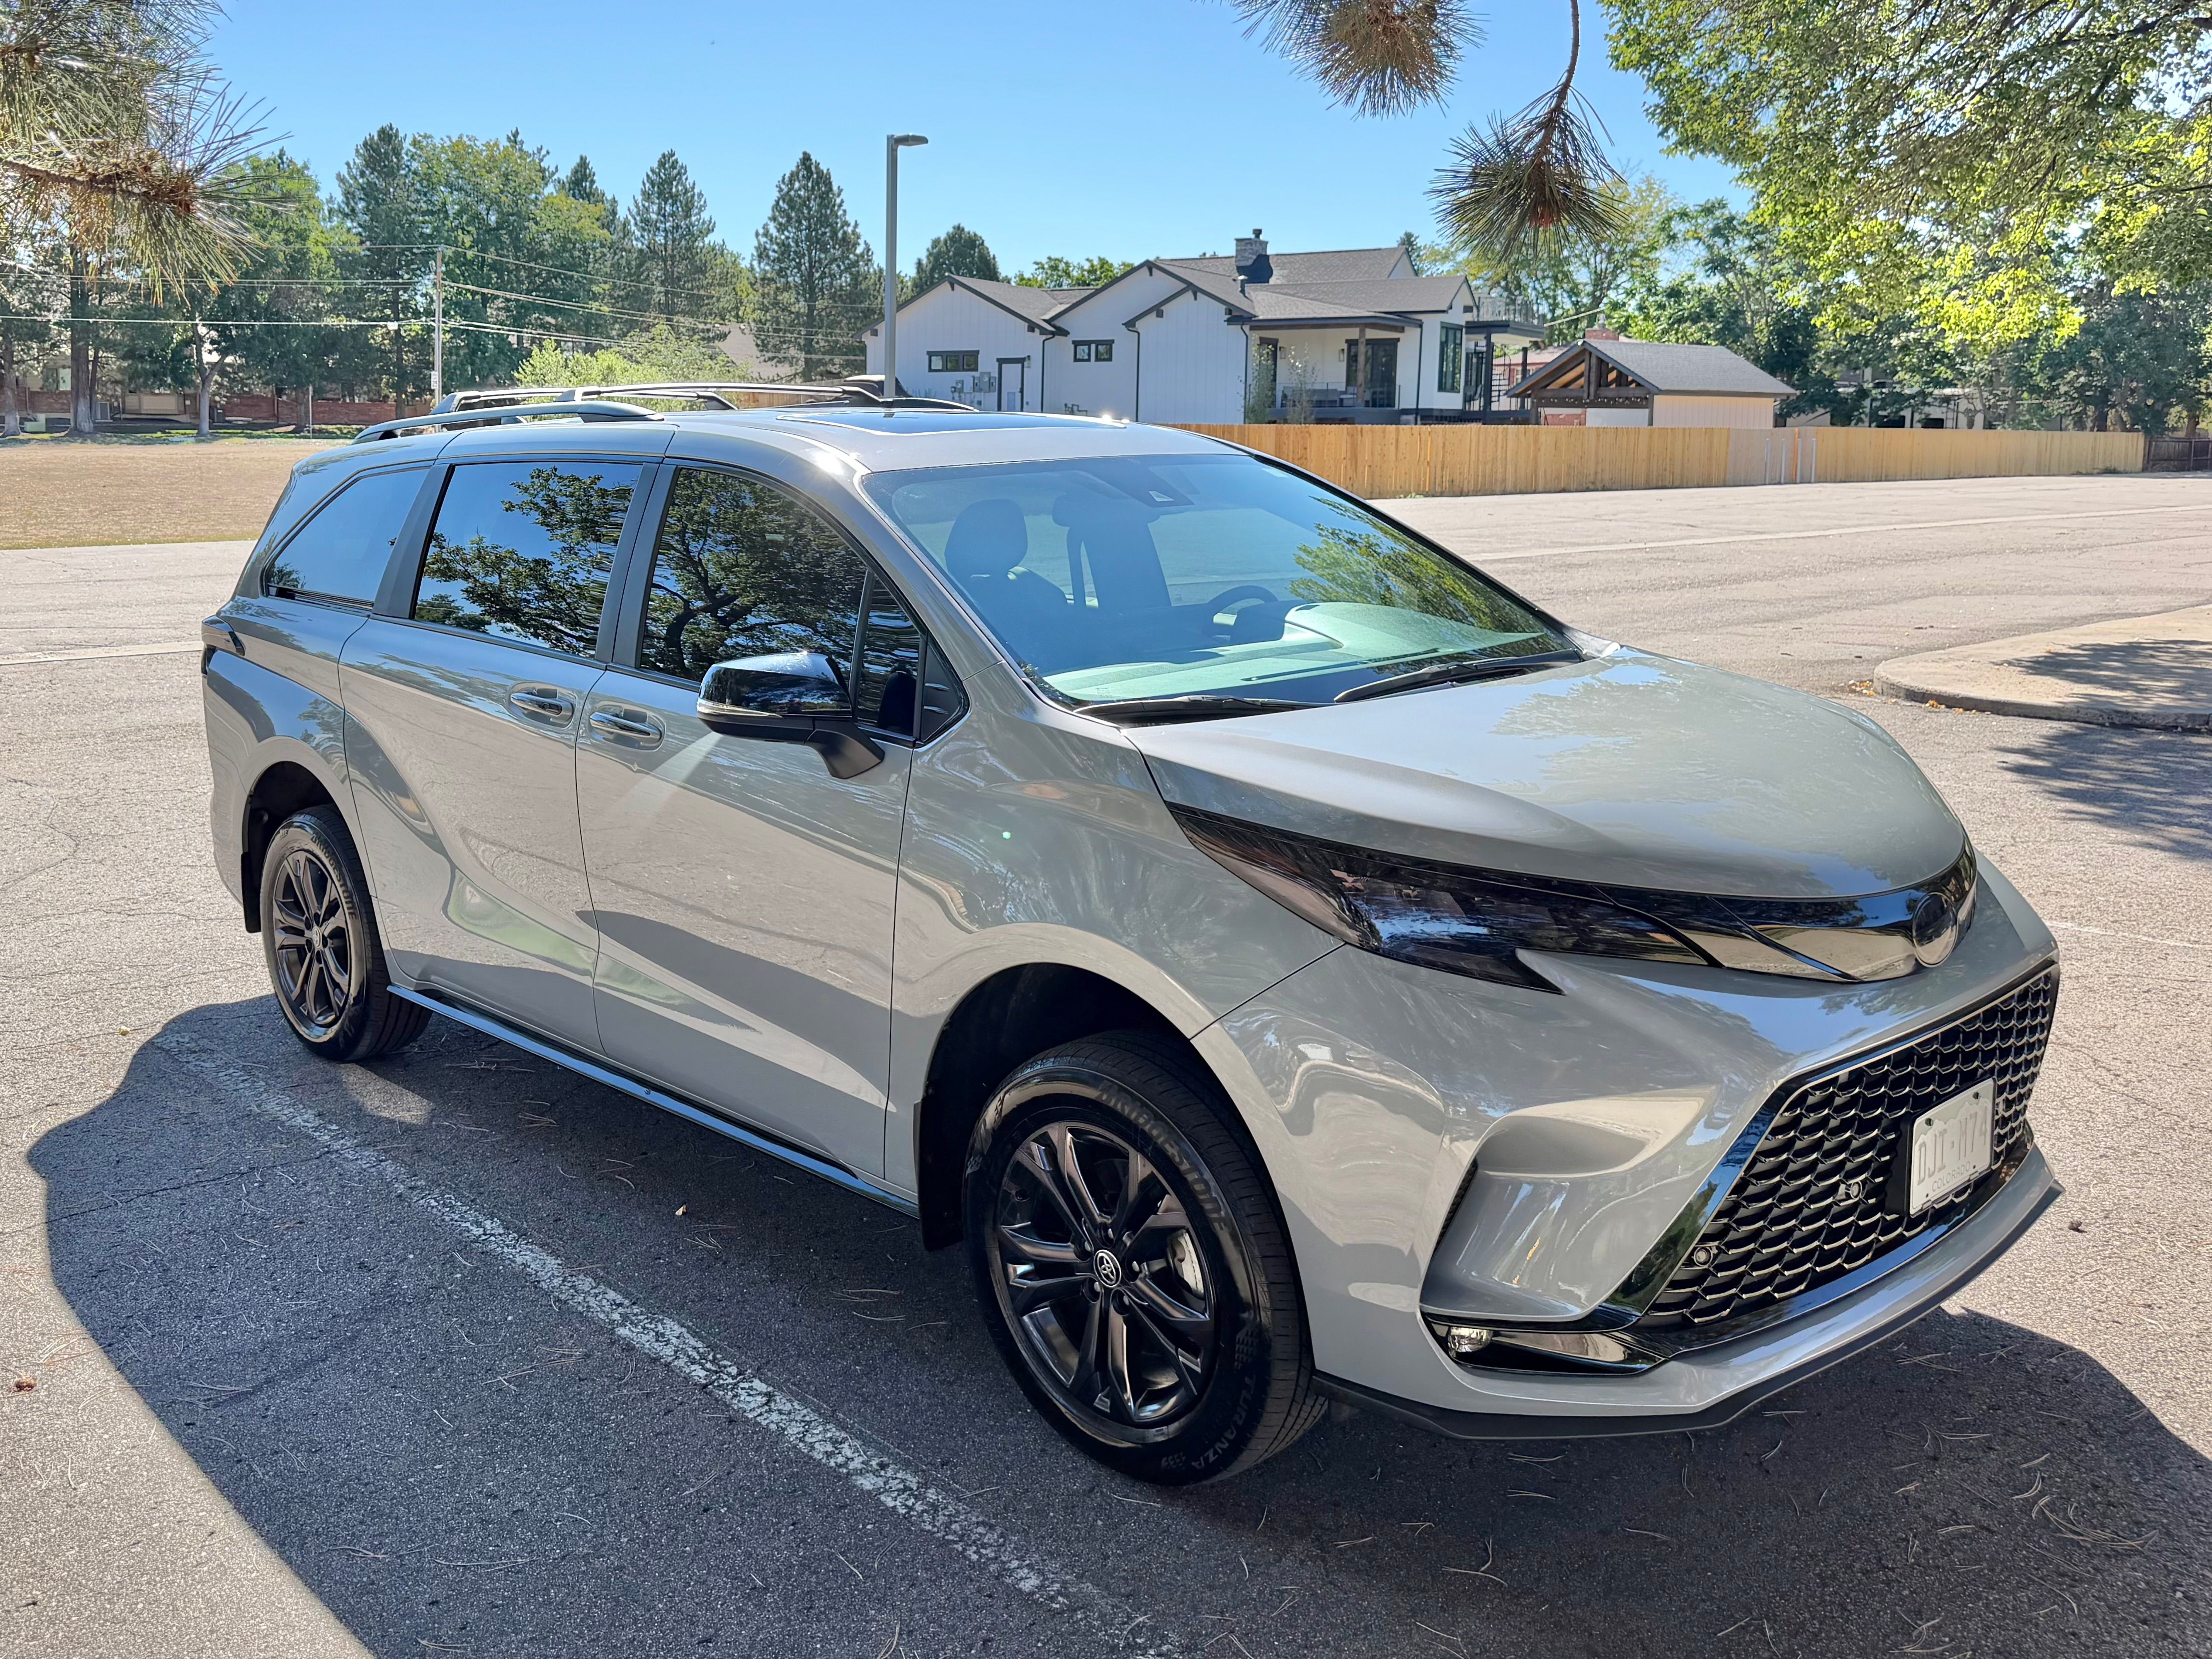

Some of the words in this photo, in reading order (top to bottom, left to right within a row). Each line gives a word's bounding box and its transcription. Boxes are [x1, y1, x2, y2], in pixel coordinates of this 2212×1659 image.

[1095, 1080, 1232, 1232] BRIDGESTONE
[1932, 1161, 1970, 1192] COLORADO
[1192, 1374, 1256, 1469] TURANZA
